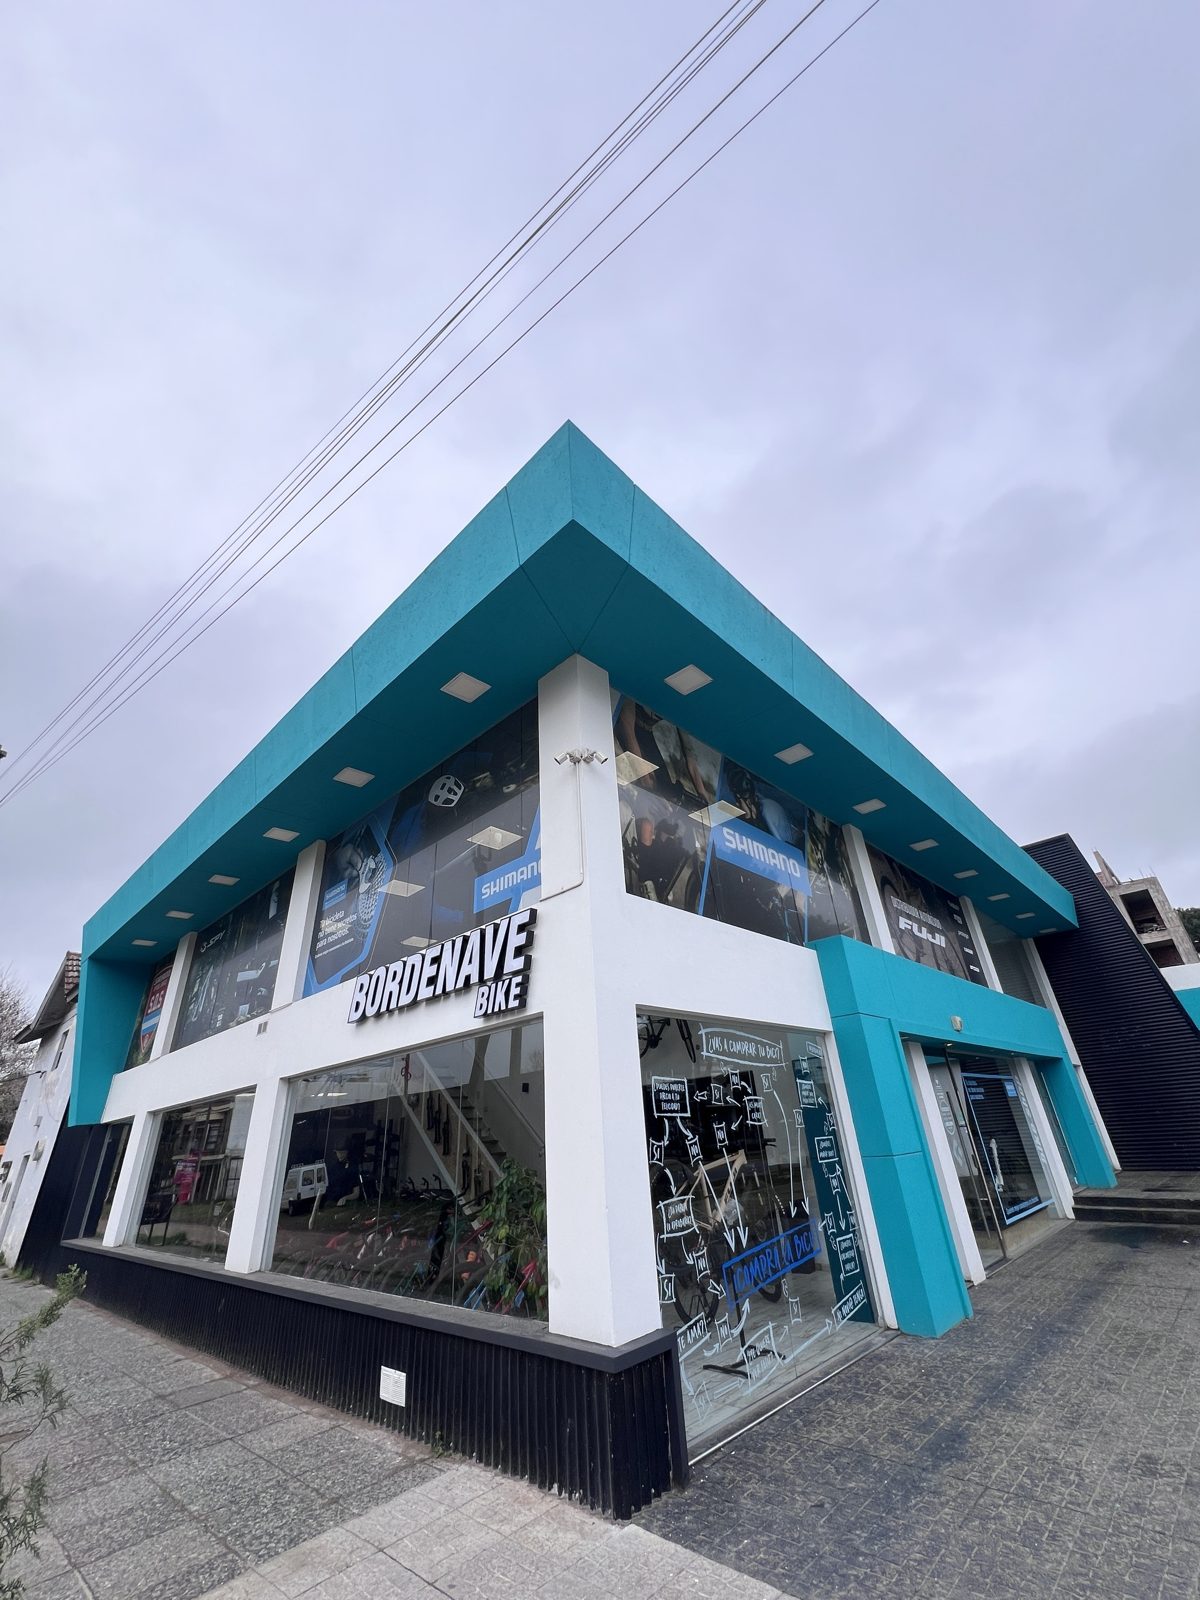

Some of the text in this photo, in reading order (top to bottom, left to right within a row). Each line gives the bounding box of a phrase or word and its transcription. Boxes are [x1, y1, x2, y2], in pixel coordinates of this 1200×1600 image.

[723, 826, 800, 878] SHIMANO
[898, 915, 946, 949] FUJI
[348, 908, 536, 1023] BORDENAVE
[474, 974, 527, 1018] BIKE
[729, 1040, 757, 1057] COMPRAR
